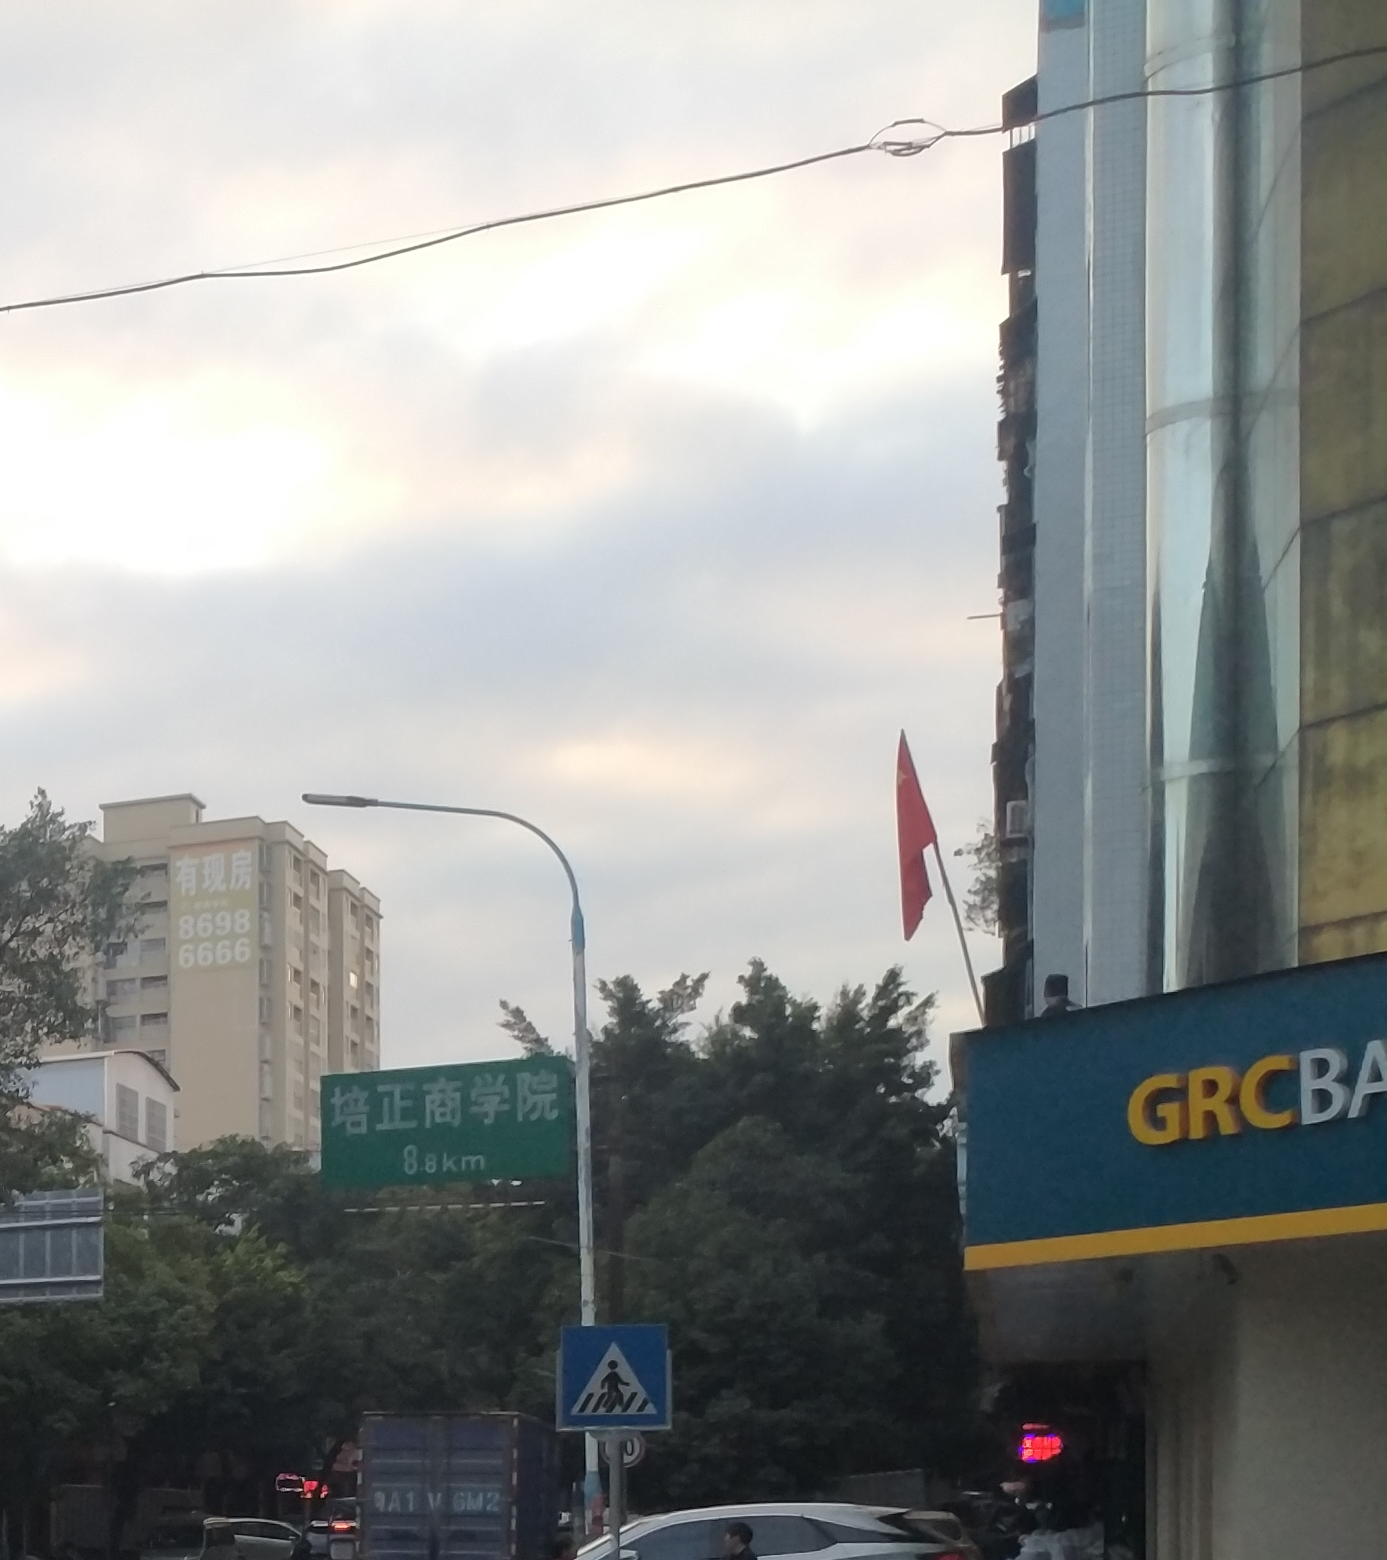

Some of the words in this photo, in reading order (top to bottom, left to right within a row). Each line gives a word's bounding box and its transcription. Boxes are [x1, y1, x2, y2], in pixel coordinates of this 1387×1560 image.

[178, 909, 251, 939] 8698
[178, 937, 251, 968] 6666
[329, 1069, 559, 1136] 培正商学院
